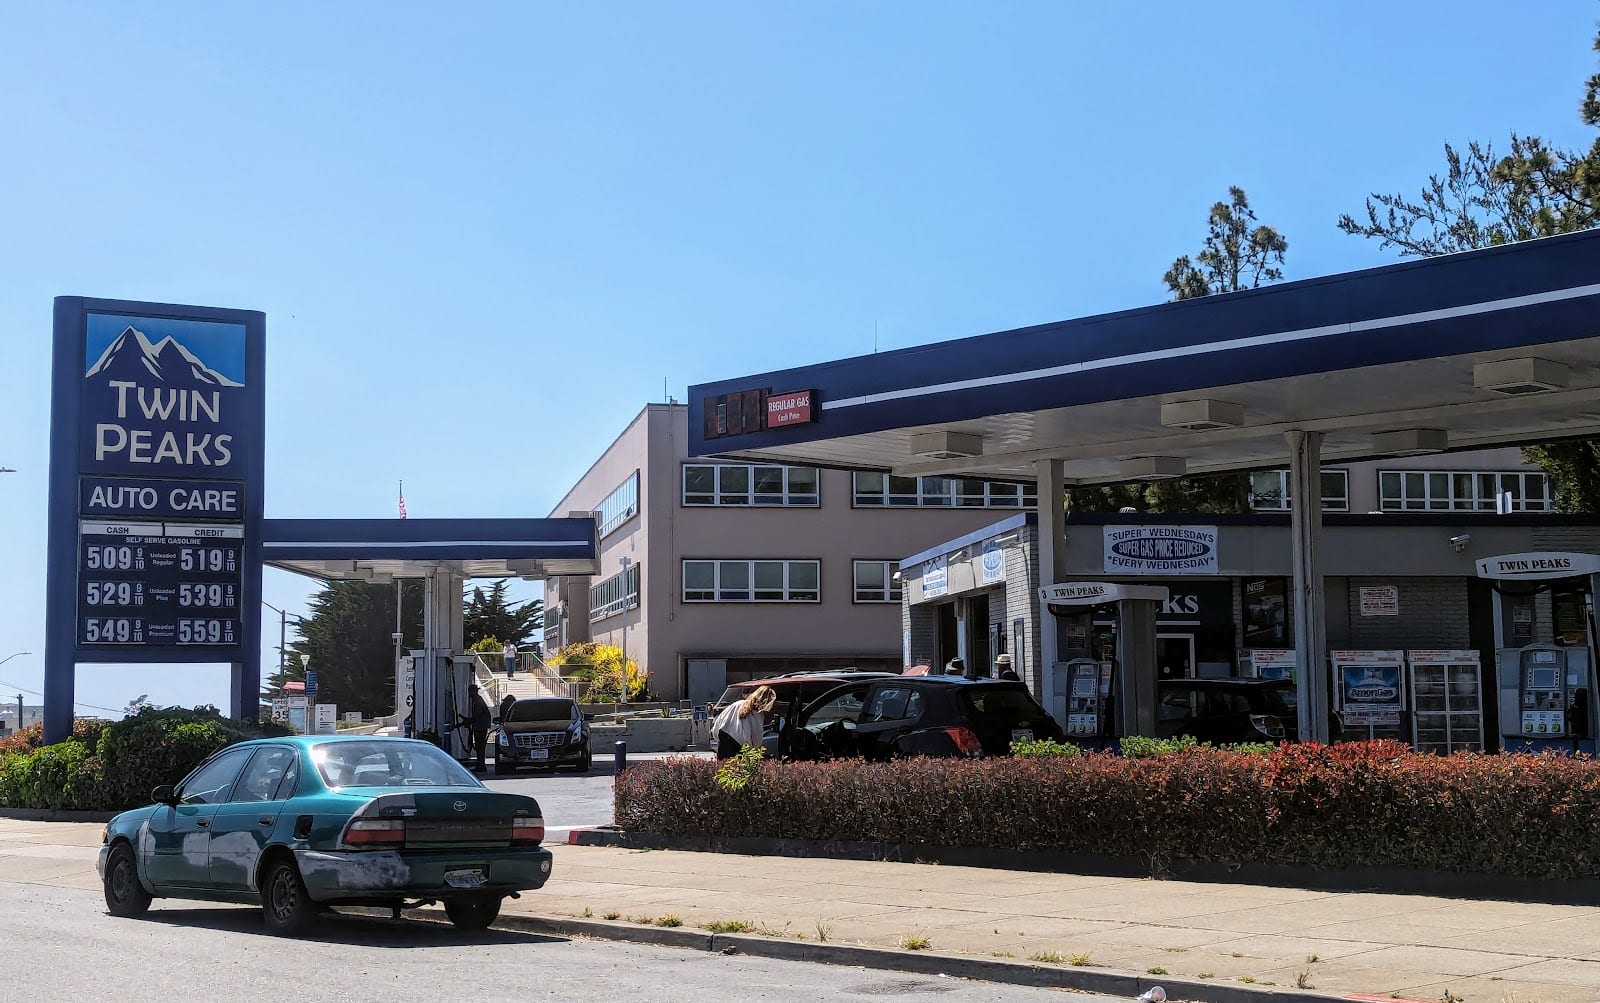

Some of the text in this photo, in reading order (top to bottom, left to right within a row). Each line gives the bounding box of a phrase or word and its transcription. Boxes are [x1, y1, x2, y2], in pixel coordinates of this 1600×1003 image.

[109, 380, 220, 423] TWIN
[768, 396, 809, 412] REGULAR GAS
[95, 423, 233, 467] PEAKS
[89, 486, 237, 512] AUTO CARE
[106, 526, 129, 534] CASH
[194, 529, 225, 537] CREDIT
[1149, 528, 1214, 542] WEDNESDAYS
[1119, 539, 1204, 557] SUPER GAS PRICE REDUCED
[87, 546, 132, 570] 509
[180, 548, 223, 571] 519
[1112, 557, 1210, 570] EVERY WEDNESDAY
[1498, 558, 1571, 571] TWIN PEAKS
[1482, 563, 1488, 574] 1
[86, 582, 131, 605] 529
[179, 584, 221, 607] 539
[1041, 590, 1047, 599] 3
[1053, 586, 1105, 597] TWIN PEAKS
[1156, 594, 1199, 614] KS
[86, 619, 130, 642] 549
[179, 620, 221, 642] 559
